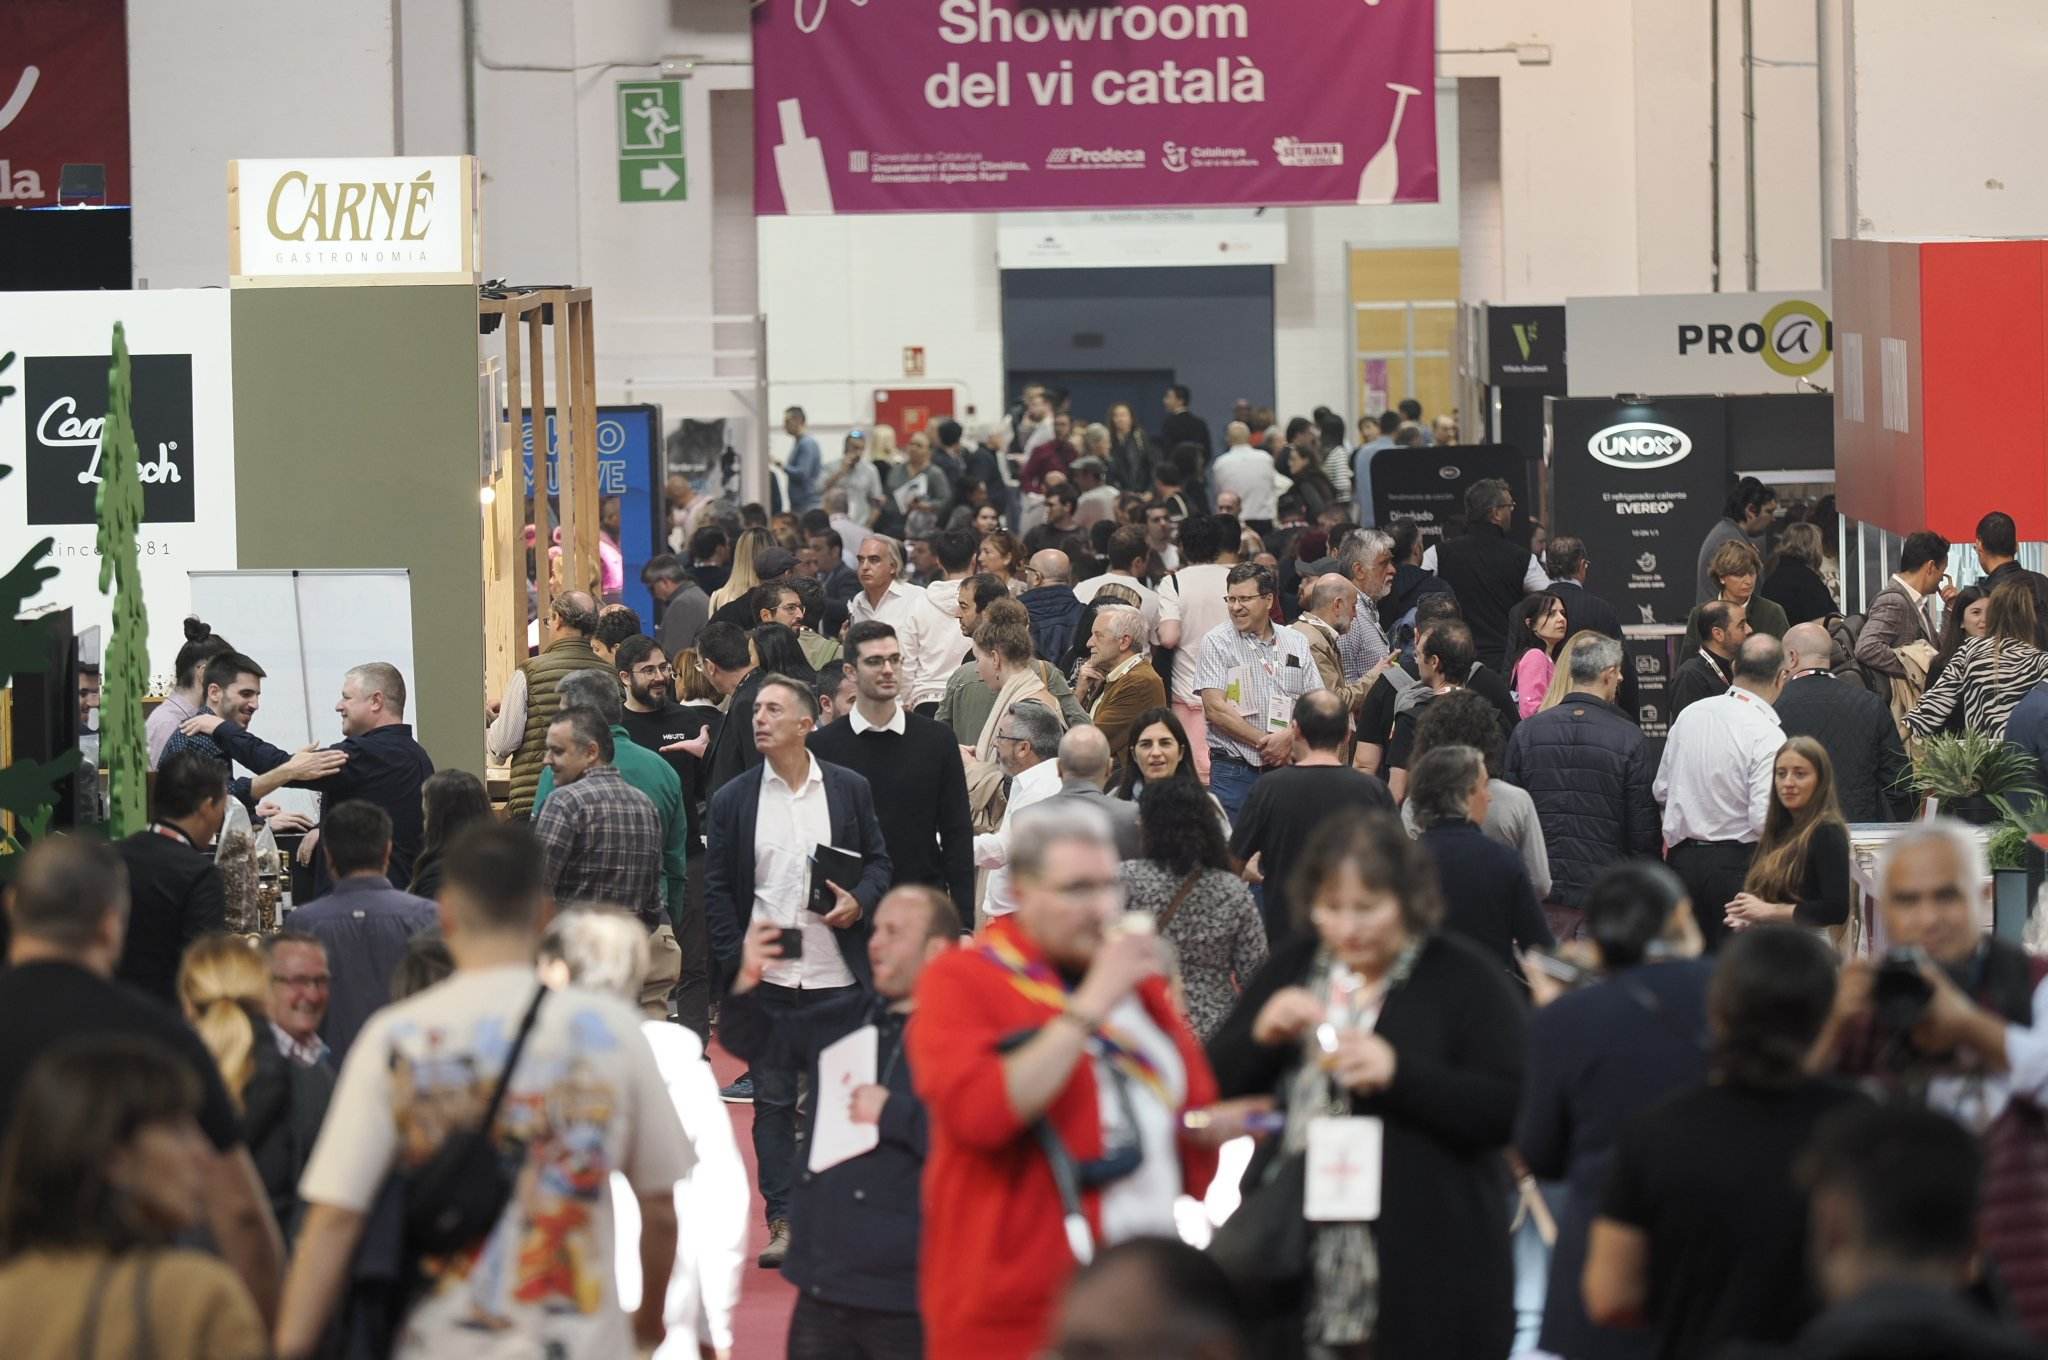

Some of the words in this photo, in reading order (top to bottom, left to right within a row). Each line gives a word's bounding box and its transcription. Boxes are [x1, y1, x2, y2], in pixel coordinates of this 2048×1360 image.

[938, 0, 1249, 43] Showroom
[924, 62, 1010, 109] del
[1026, 60, 1073, 106] vi
[1091, 56, 1266, 105] català
[1070, 148, 1146, 163] Prodeca
[266, 170, 435, 242] CARNÉ
[275, 251, 427, 264] GASTRONOMIA
[1600, 436, 1674, 456] UNOX
